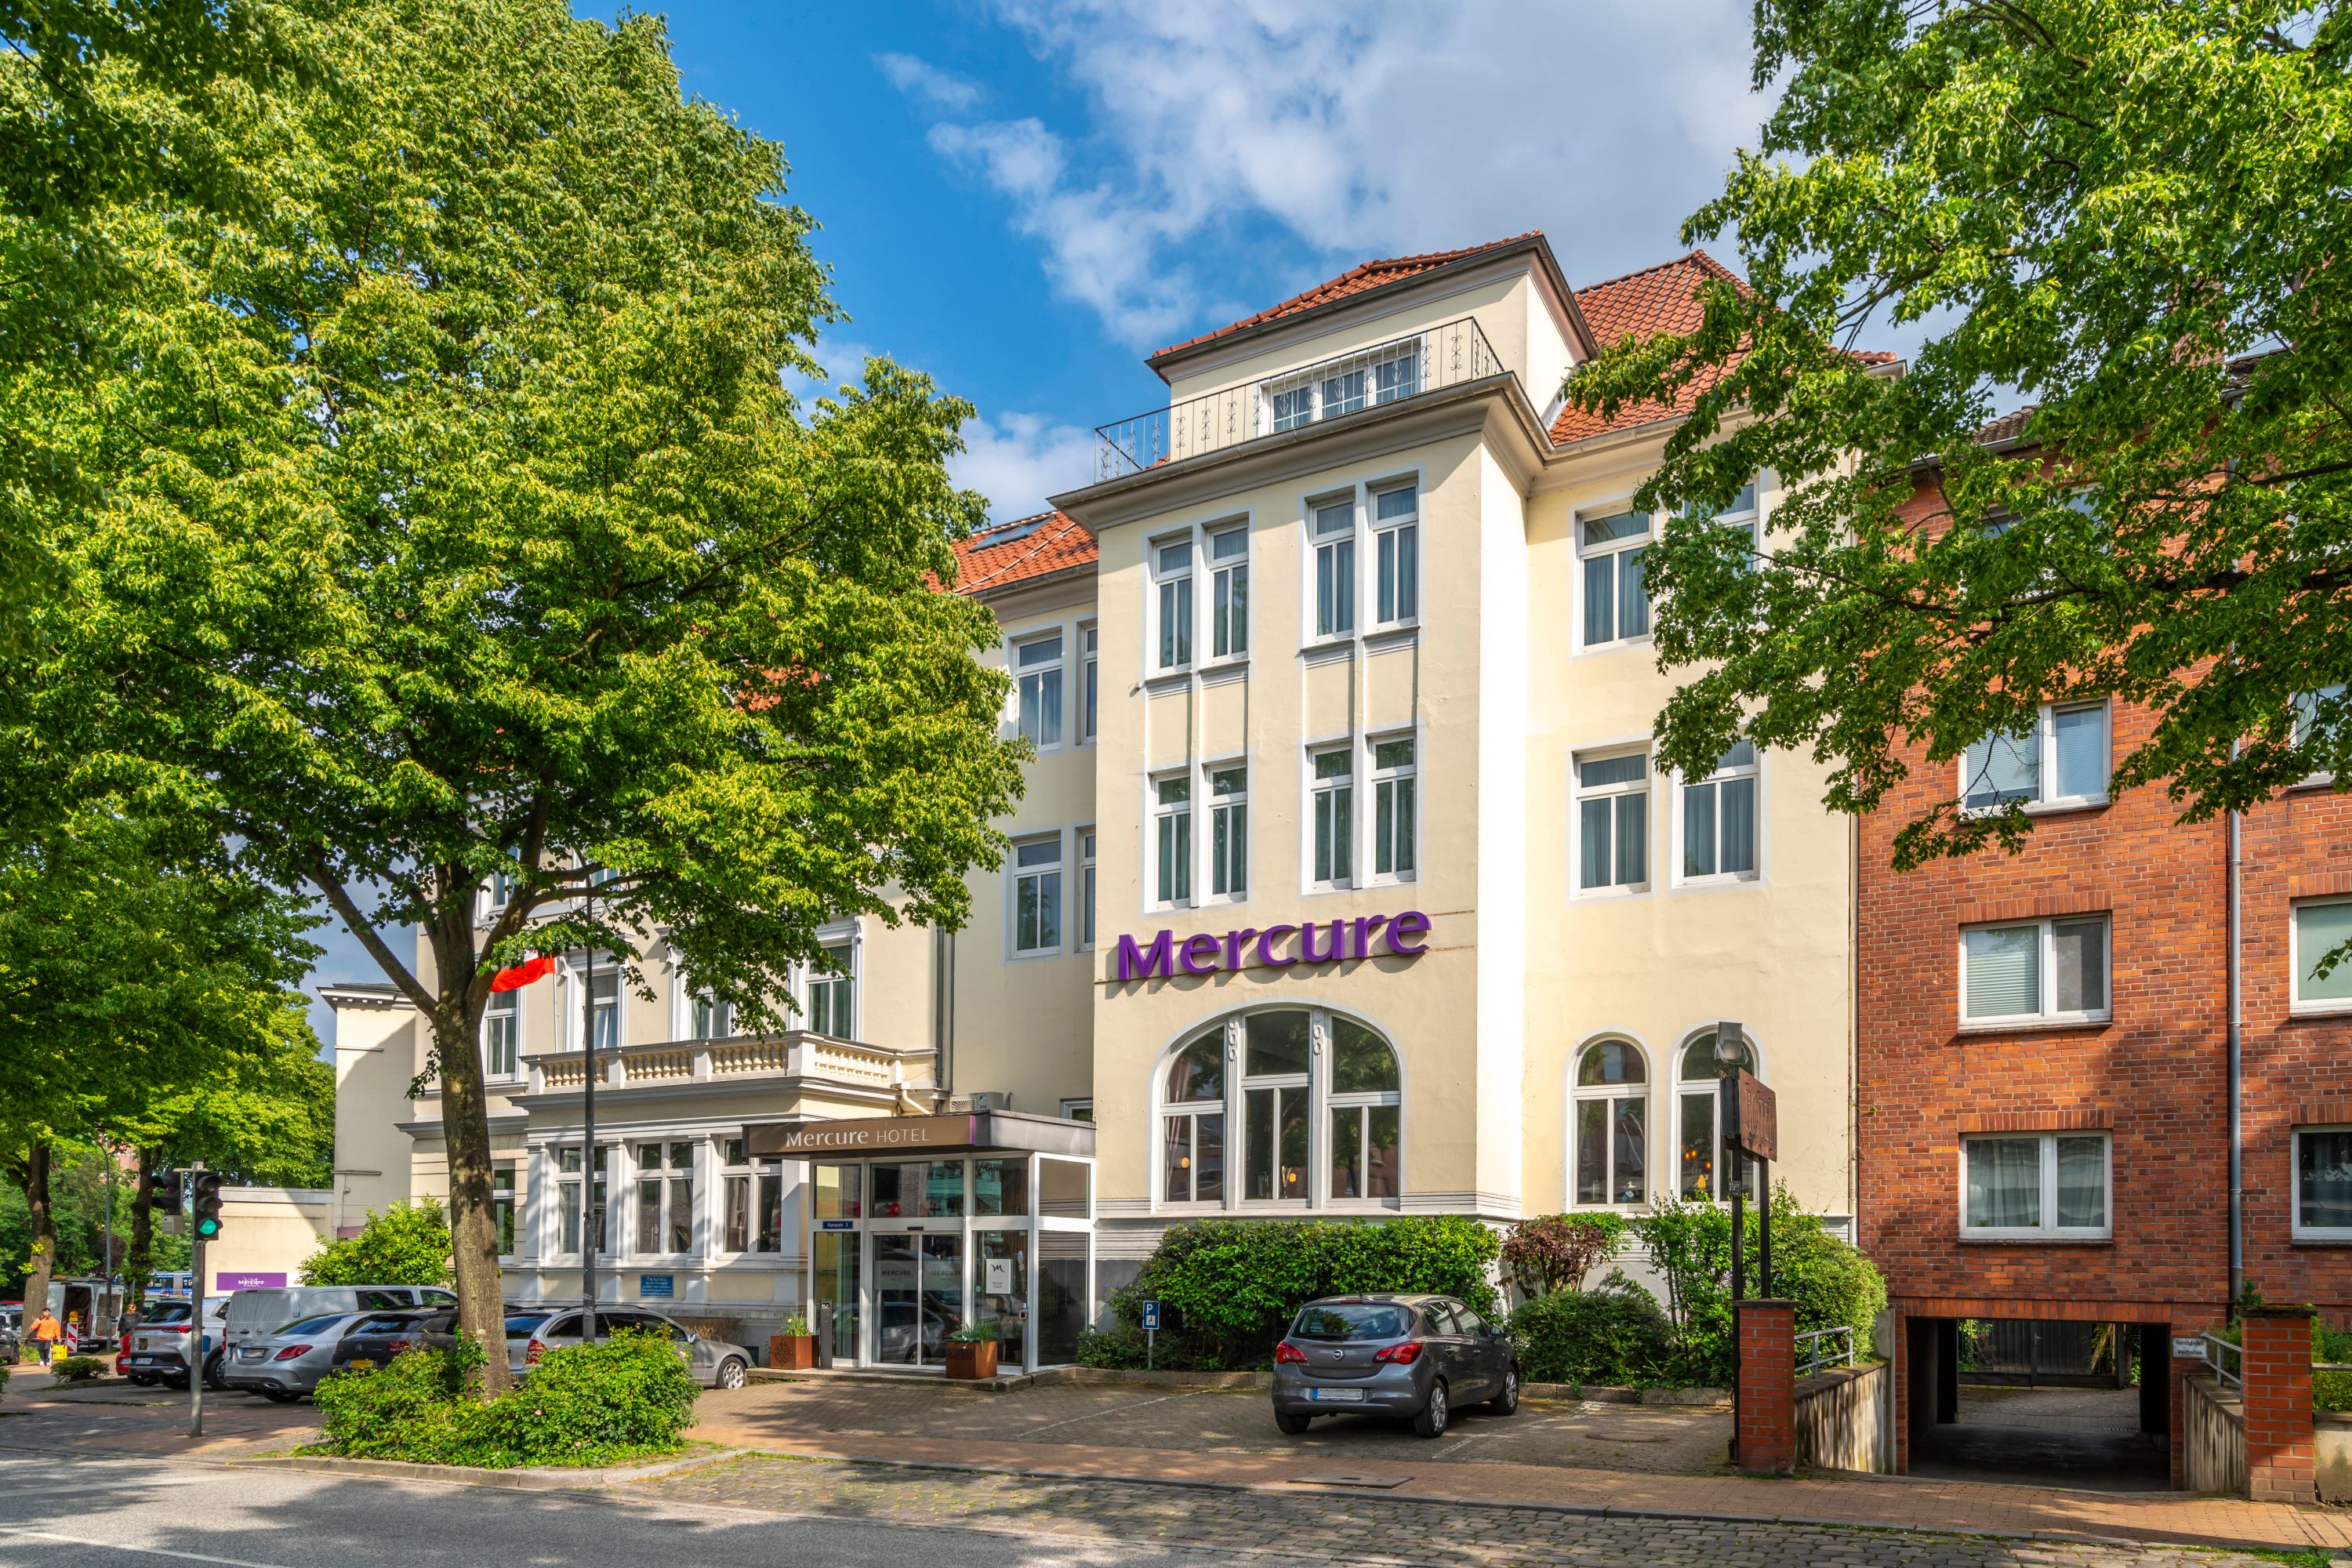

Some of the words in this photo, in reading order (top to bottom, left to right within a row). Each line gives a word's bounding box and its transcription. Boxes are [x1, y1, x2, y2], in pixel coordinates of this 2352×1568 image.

[1117, 909, 1432, 982] Mercure
[1744, 1090, 1774, 1143] HOTEL
[786, 1131, 869, 1148] Mercure
[877, 1128, 930, 1143] HOTEL
[1146, 1303, 1153, 1315] P
